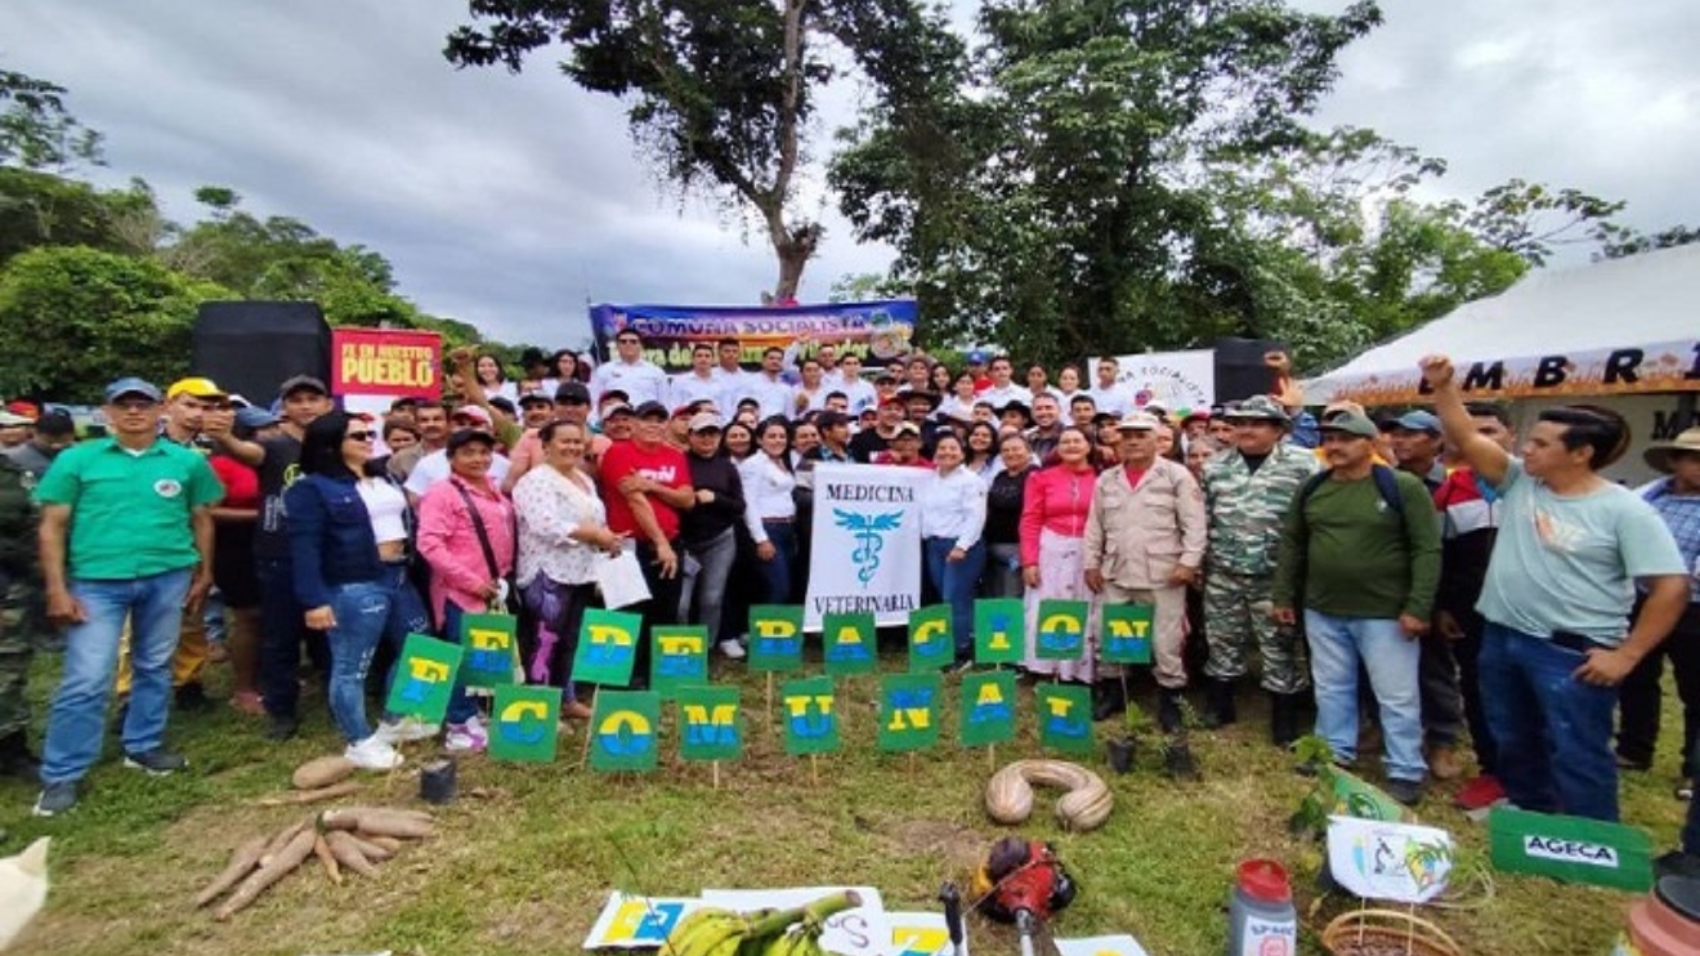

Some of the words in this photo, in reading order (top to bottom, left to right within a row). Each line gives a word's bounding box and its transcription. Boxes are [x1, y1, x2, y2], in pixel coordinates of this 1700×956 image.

[632, 317, 738, 336] COMUNA
[743, 315, 866, 334] SOCIALISTA
[342, 359, 435, 388] PUEBLO
[827, 484, 914, 502] MEDICINA
[815, 594, 914, 614] VETERINARIA
[1528, 836, 1614, 861] AGECA
